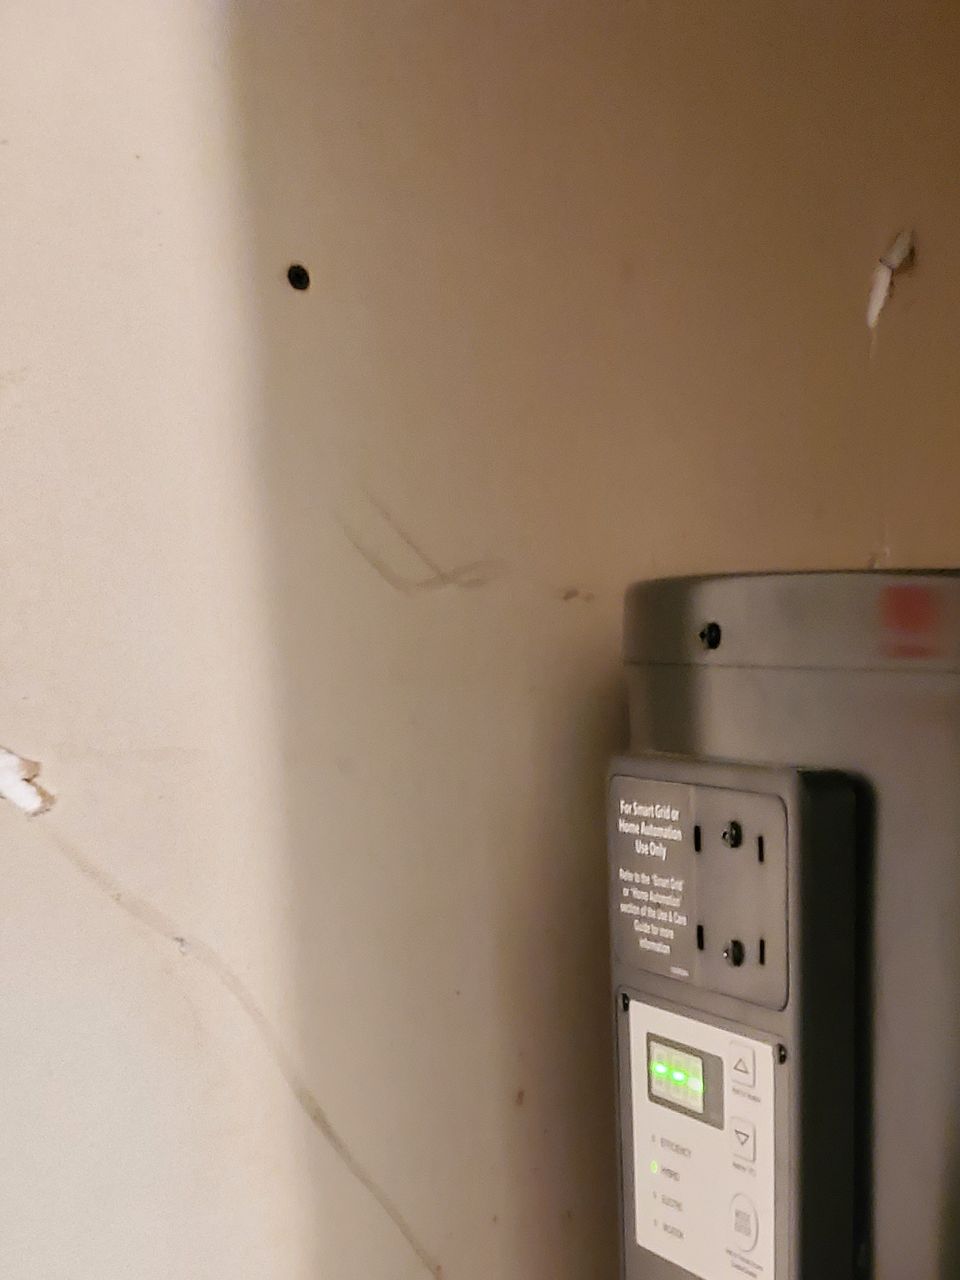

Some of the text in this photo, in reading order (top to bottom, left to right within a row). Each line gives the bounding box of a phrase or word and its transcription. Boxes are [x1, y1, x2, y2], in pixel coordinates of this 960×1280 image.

[619, 799, 632, 815] For
[633, 801, 655, 819] Smart
[655, 804, 671, 820] Grid
[618, 818, 683, 841] Home Automation
[634, 838, 667, 861] Use Only
